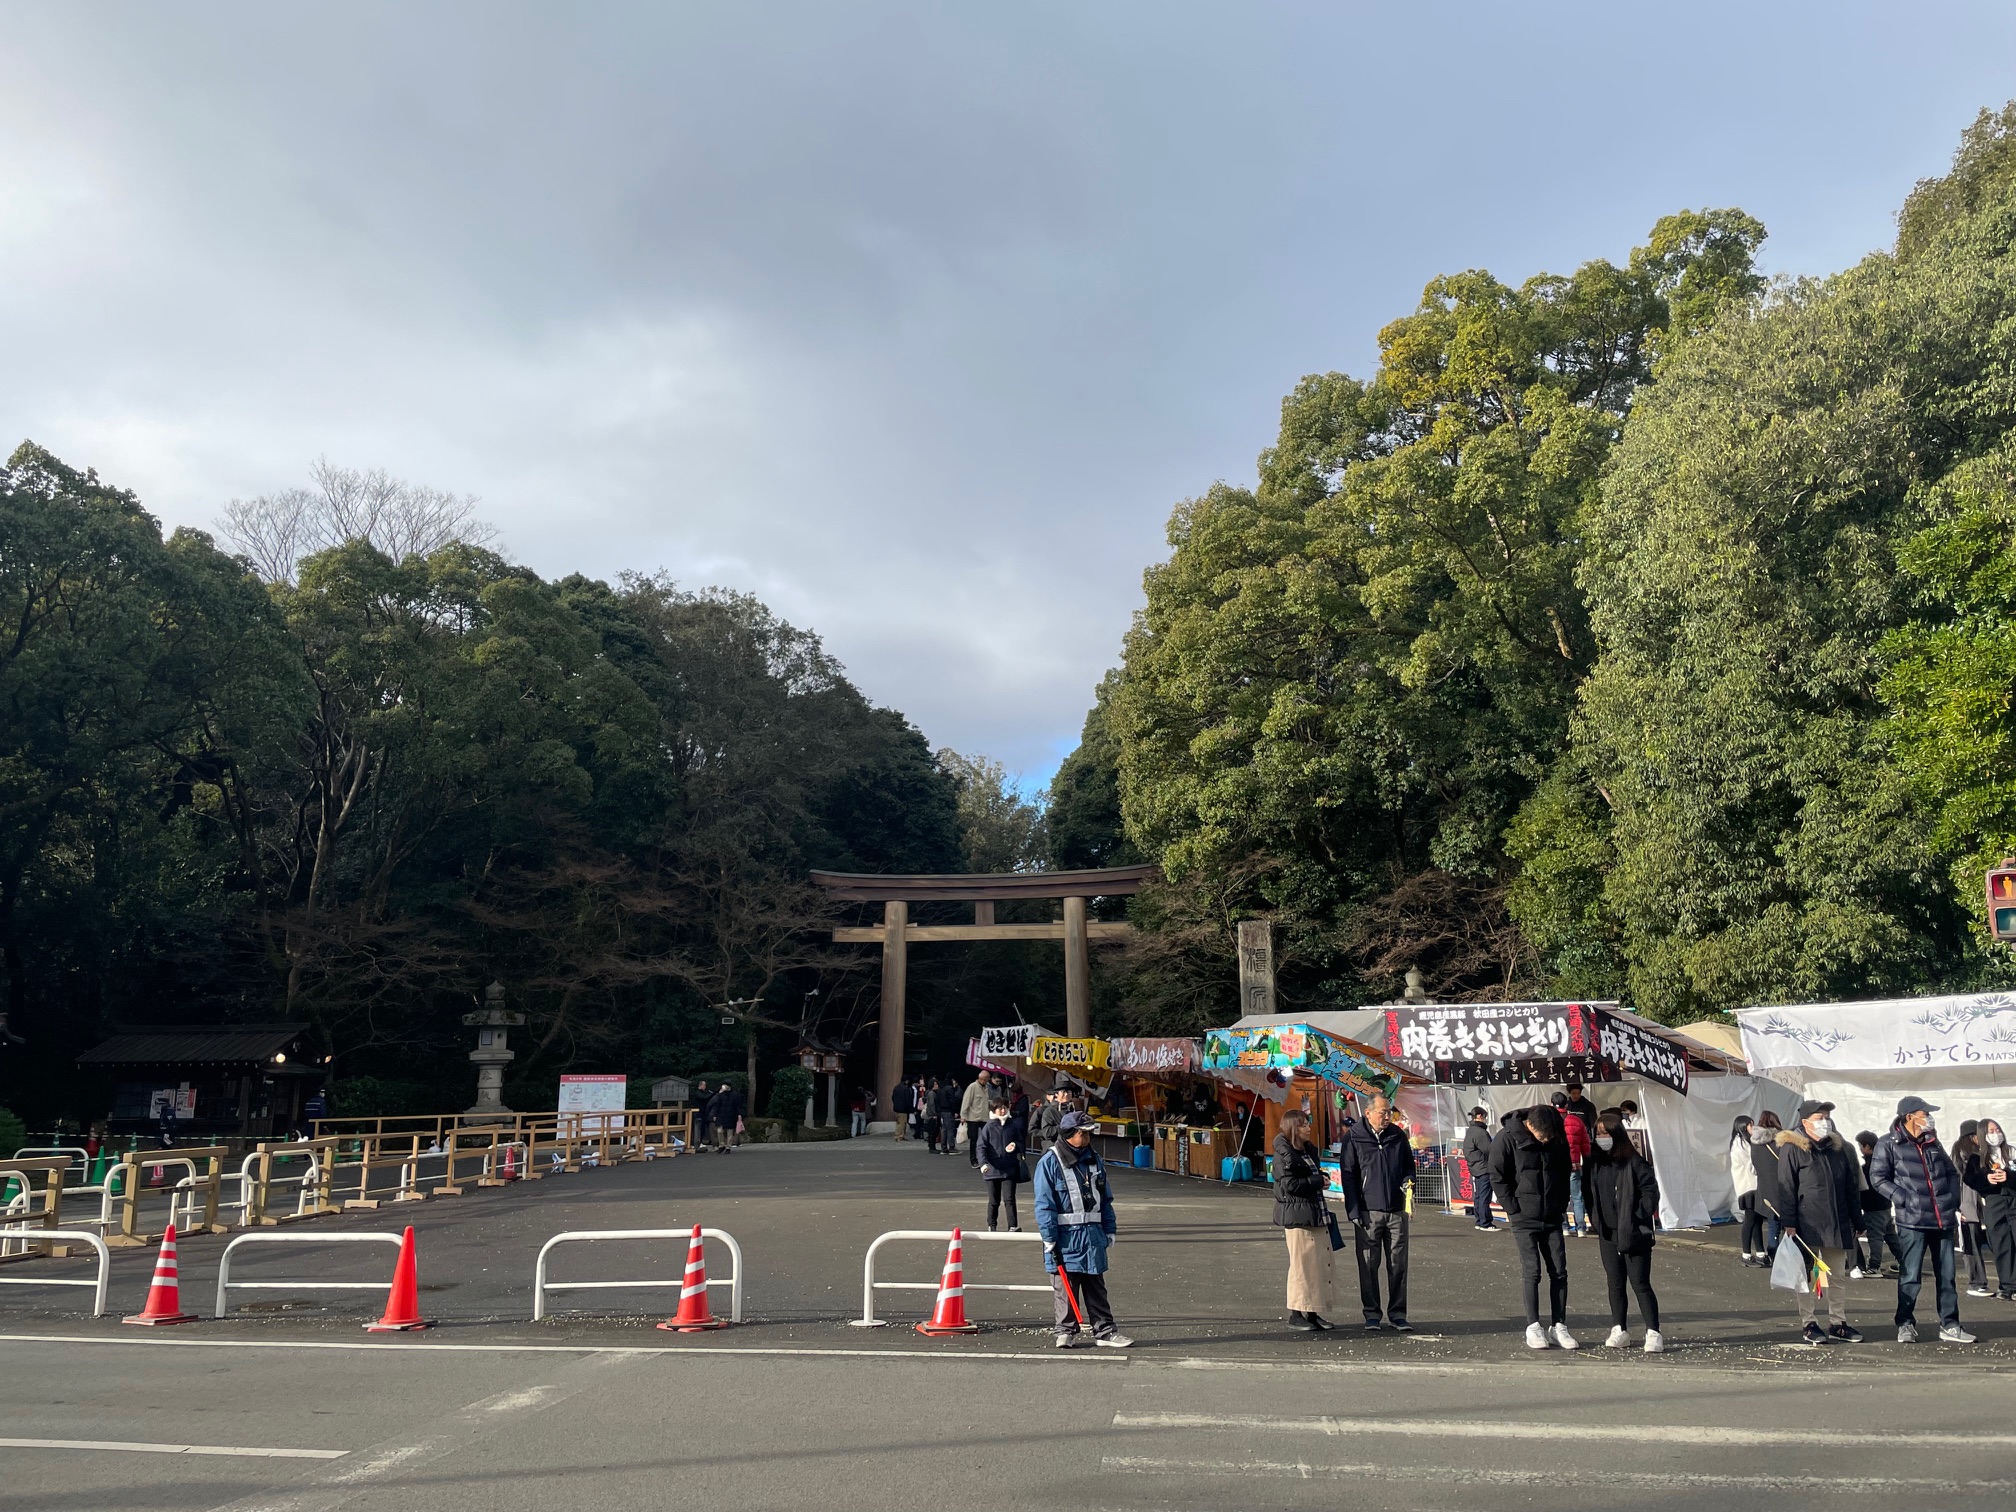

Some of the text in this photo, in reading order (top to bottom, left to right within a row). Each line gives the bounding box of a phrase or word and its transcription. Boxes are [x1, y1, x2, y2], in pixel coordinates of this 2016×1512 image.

[1473, 1007, 1539, 1019] 秋田産コシヒカリ
[1567, 1004, 1585, 1054] 宮崎名物
[986, 1027, 1029, 1053] やきそば
[1386, 1011, 1403, 1057] 宮崎名物
[1400, 1016, 1569, 1060] 肉巻きおにぎり
[1044, 1041, 1087, 1063] とうもろこし
[1599, 1024, 1686, 1089] 肉巻きおにぎり
[1893, 1042, 2016, 1065] かすてら MATS
